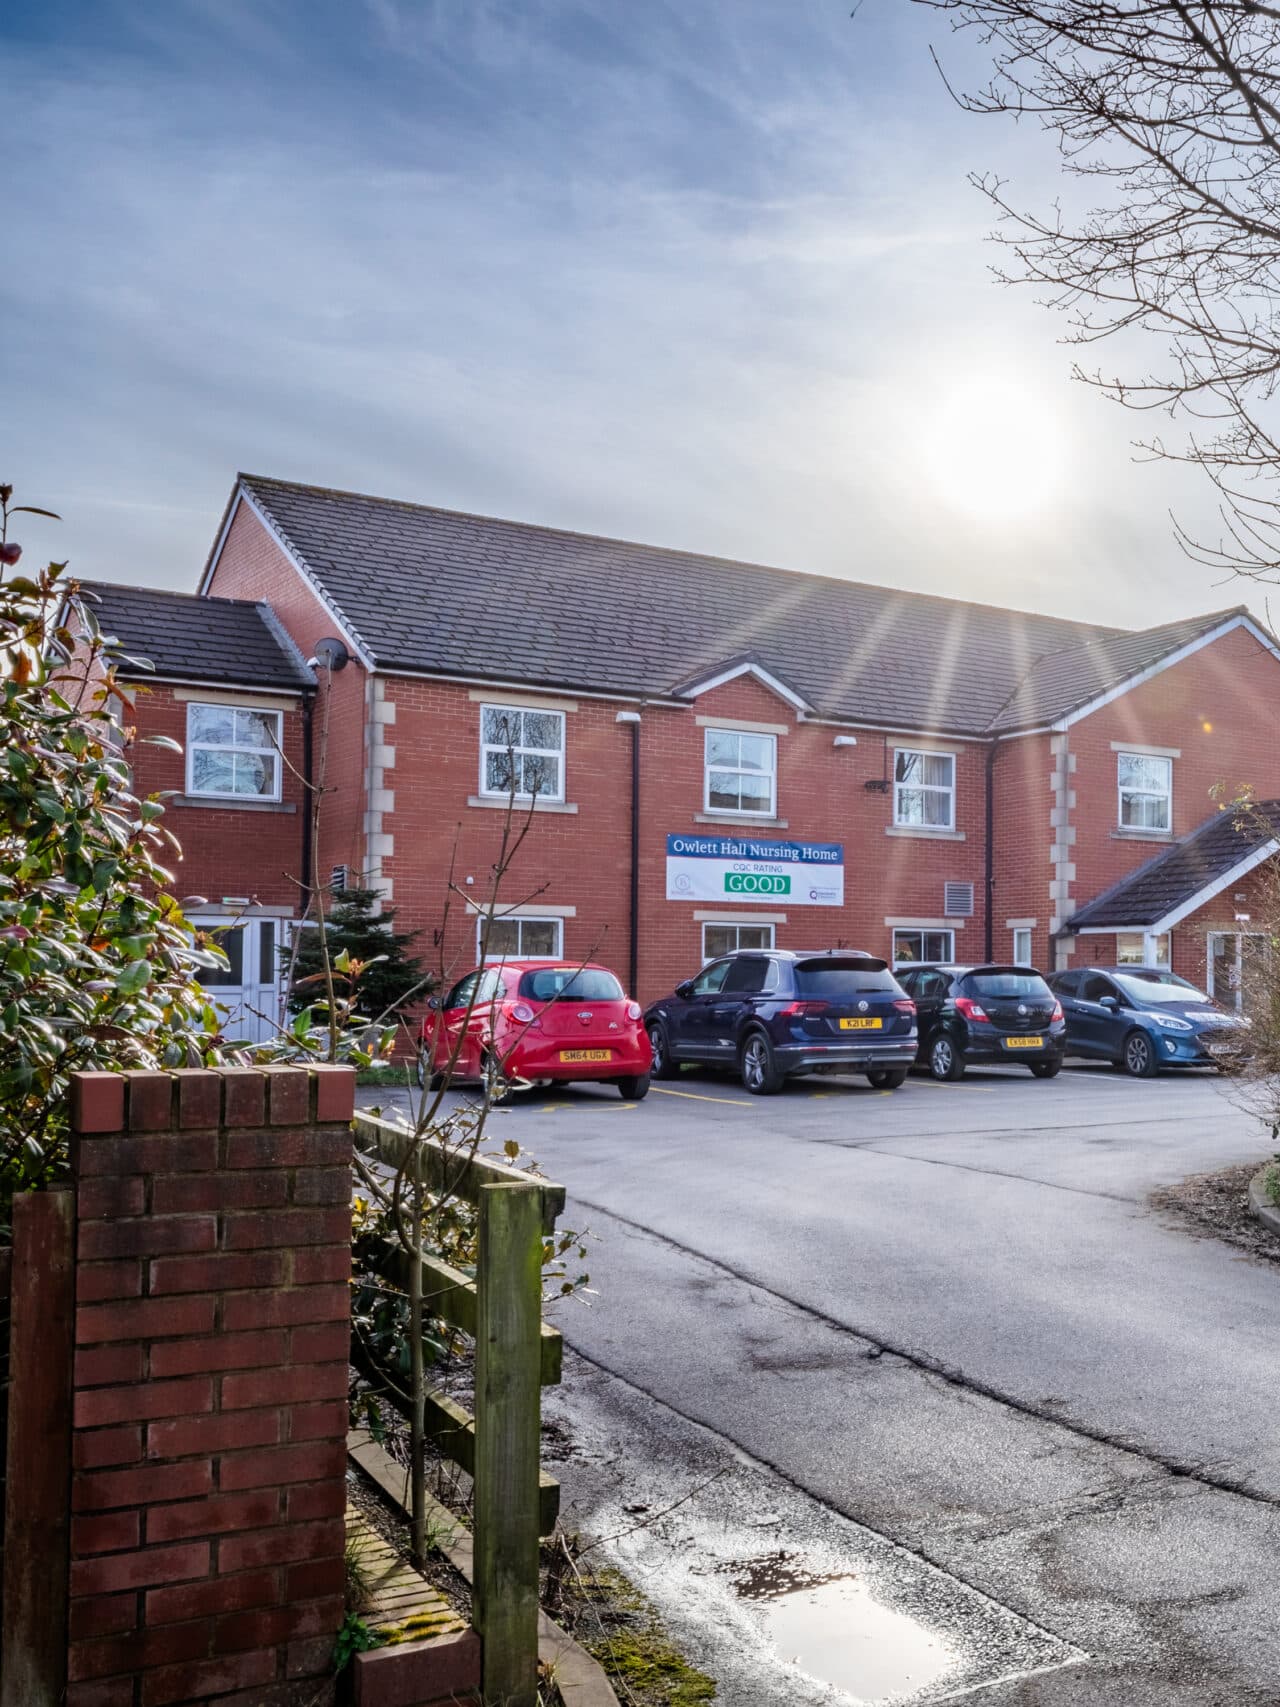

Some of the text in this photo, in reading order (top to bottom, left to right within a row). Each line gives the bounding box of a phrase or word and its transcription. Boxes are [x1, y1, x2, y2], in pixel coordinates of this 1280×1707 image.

[673, 839, 838, 861] Owlett Hall Nursing Home
[733, 863, 783, 874] CQC RATING
[728, 874, 786, 892] GOOD
